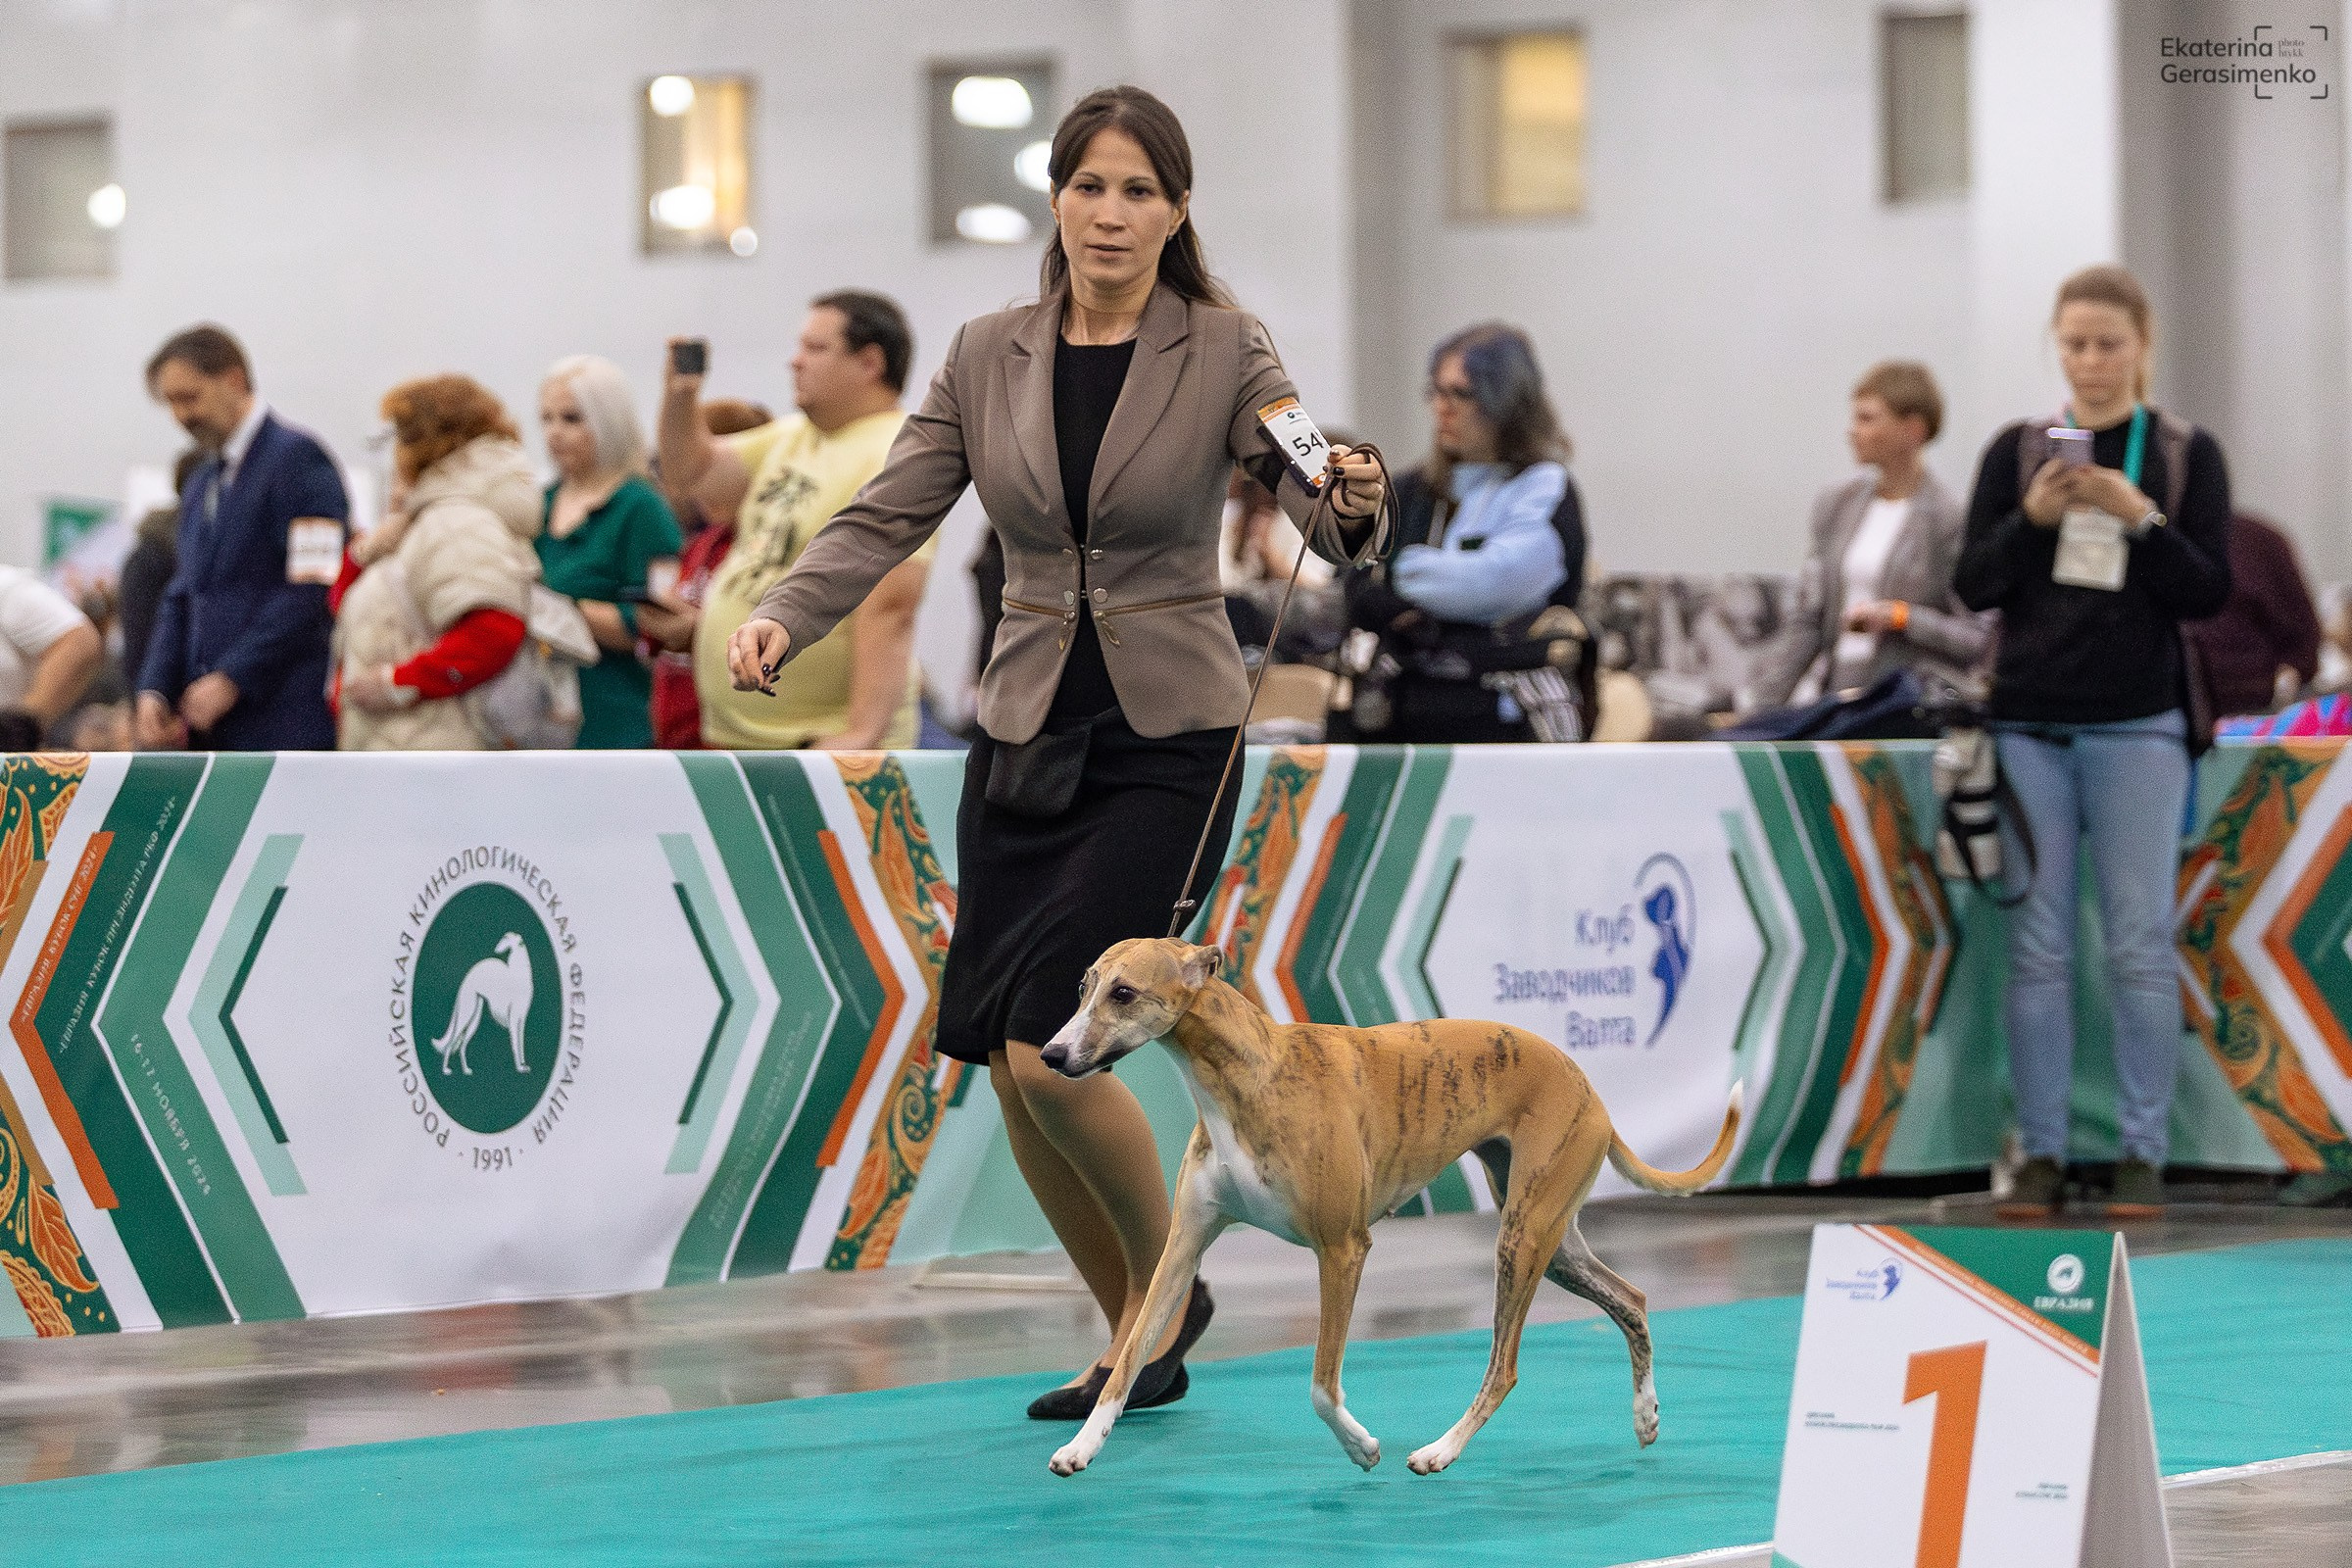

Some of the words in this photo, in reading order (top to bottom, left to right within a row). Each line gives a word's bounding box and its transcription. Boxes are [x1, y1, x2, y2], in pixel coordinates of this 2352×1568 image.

[1292, 432, 1324, 457] 54
[409, 845, 577, 954] КИНОЛОГИЧЕСКАЯ
[1576, 903, 1636, 956] Клуб
[1494, 962, 1636, 1004] Заводчиков
[389, 931, 450, 1148] РОССИЙСКАЯ
[532, 962, 586, 1145] ФЕДЕРАЦИЯ
[1567, 1011, 1636, 1049] Валта
[472, 1147, 514, 1171] 1991
[1901, 1340, 1987, 1568] 1
